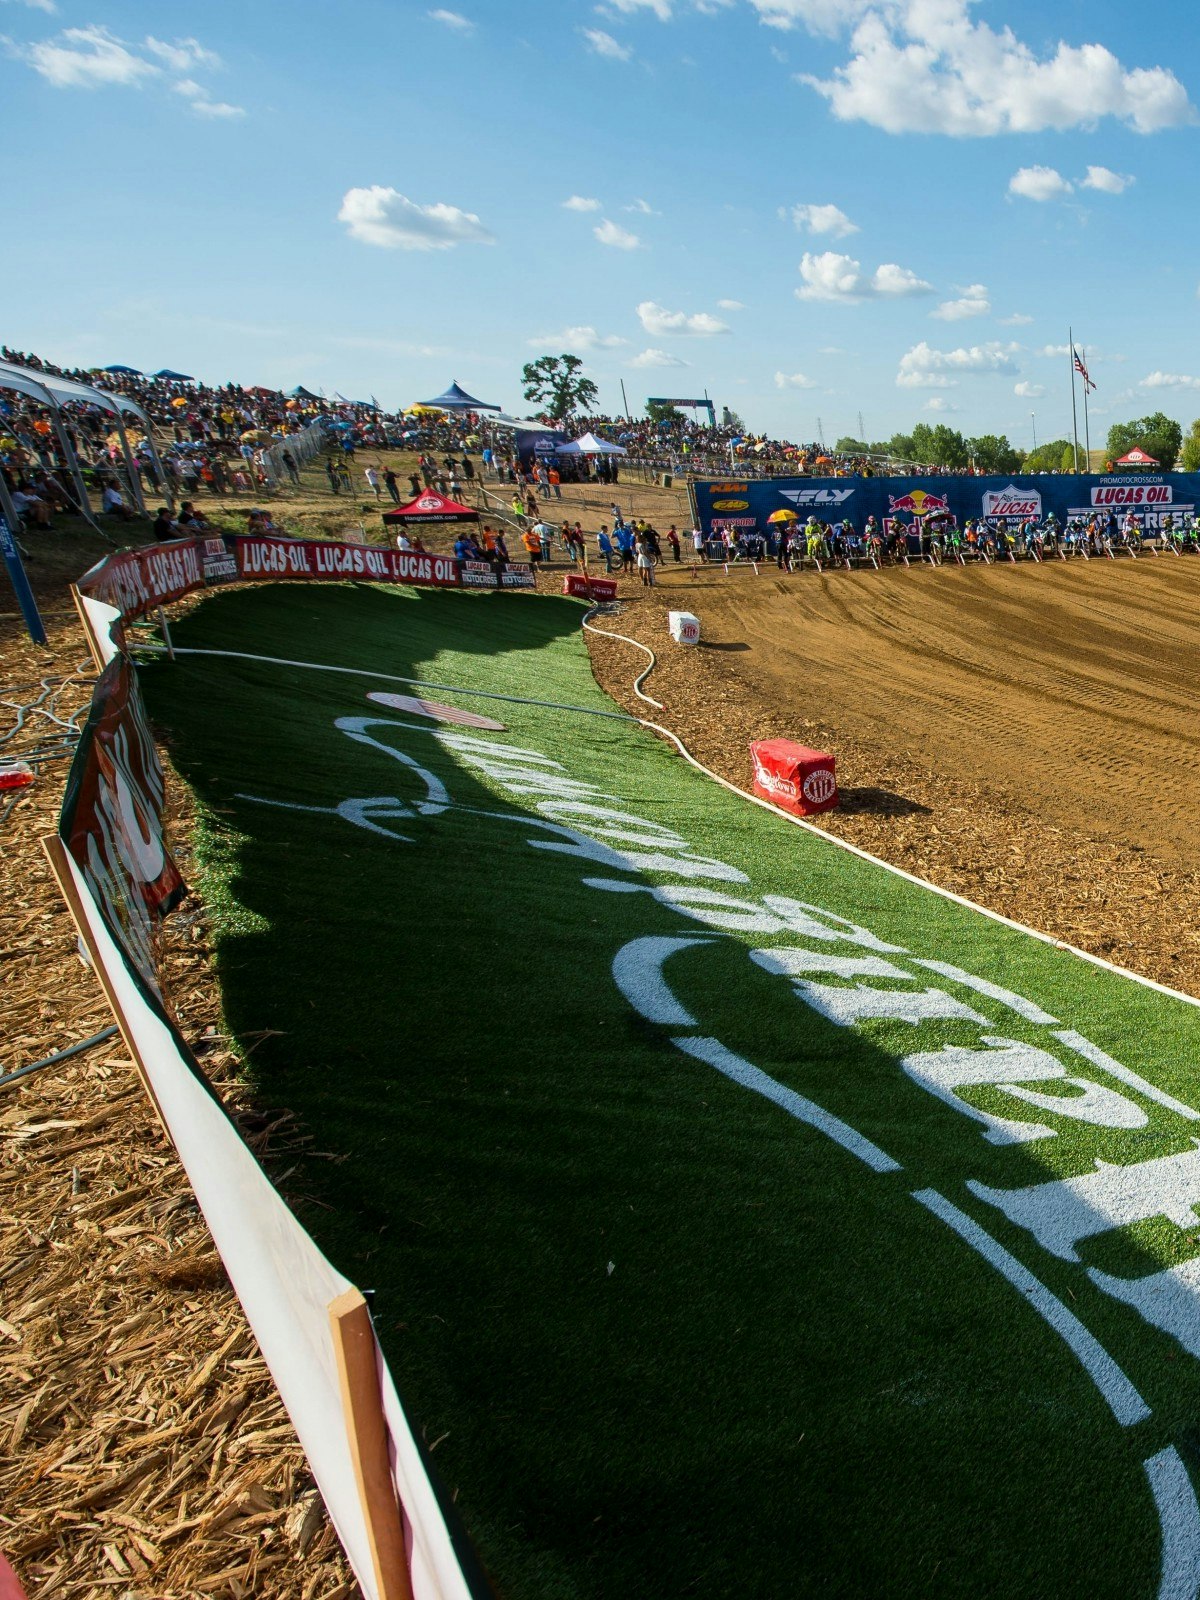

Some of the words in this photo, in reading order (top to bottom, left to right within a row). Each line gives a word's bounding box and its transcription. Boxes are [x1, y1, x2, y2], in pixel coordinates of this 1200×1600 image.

[709, 483, 748, 493] KTM
[778, 489, 856, 502] FLY
[1094, 487, 1145, 505] LUCAS
[1146, 486, 1169, 503] OIL
[990, 501, 1038, 515] LUCAS
[243, 543, 287, 573] LUCAS
[291, 545, 311, 573] OIL
[316, 547, 364, 574] LUCAS
[366, 551, 390, 575] OIL
[392, 554, 432, 580] LUCAS
[435, 560, 456, 582] OIL
[147, 550, 186, 597] LUCAS
[182, 547, 200, 585] OIL
[461, 574, 498, 585] MOTOCROSS
[574, 584, 613, 595] Hatown
